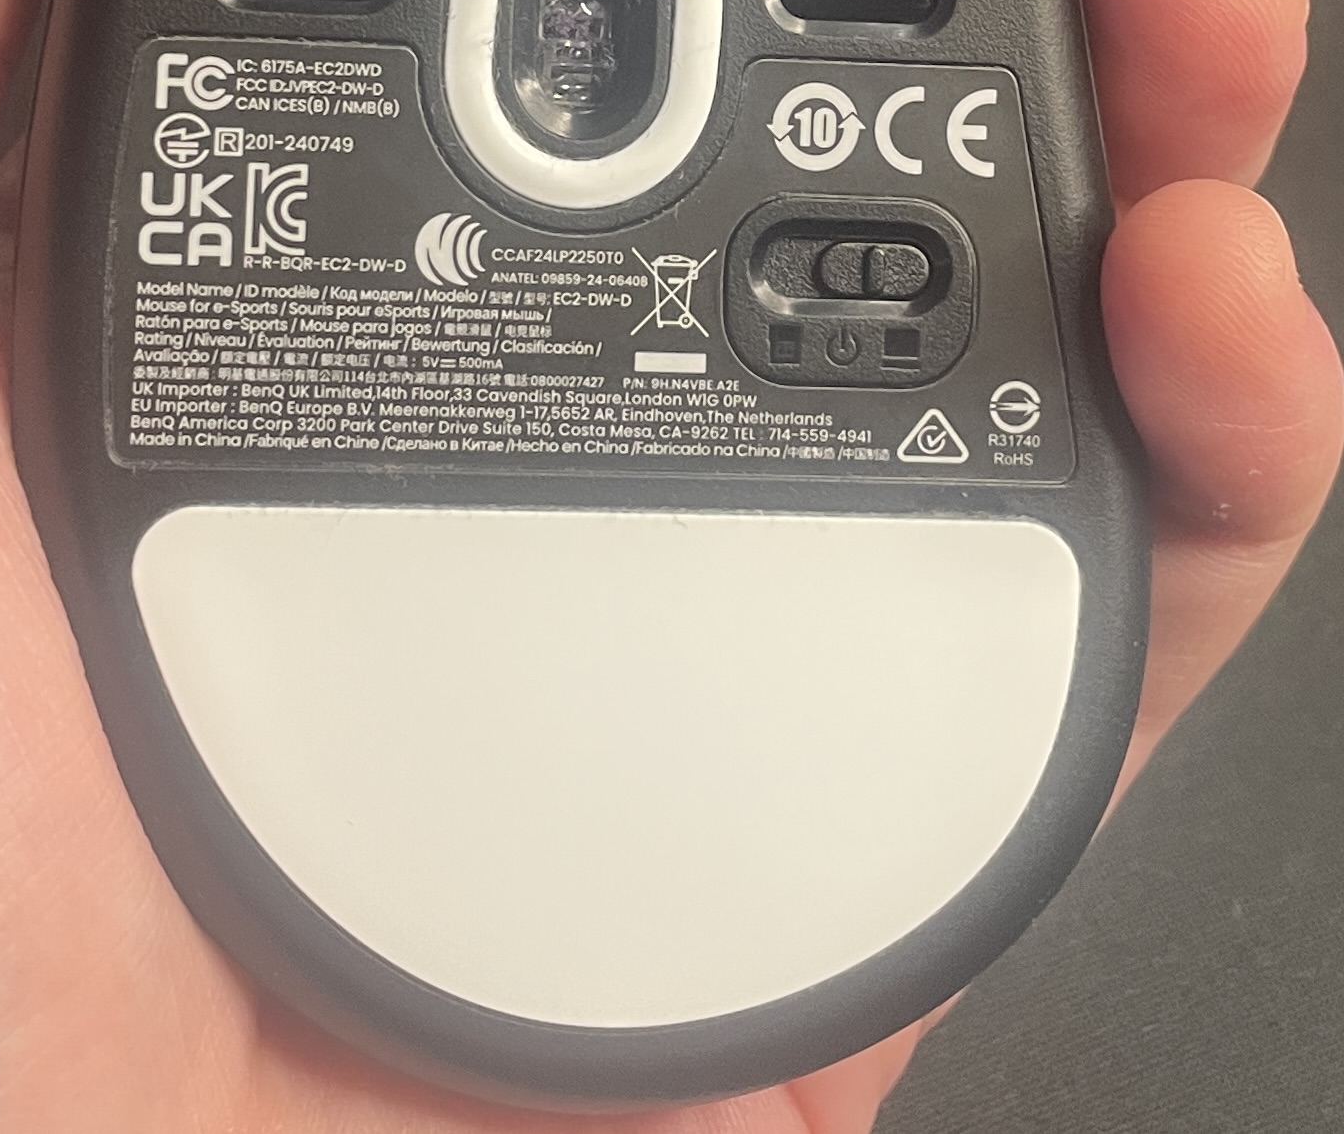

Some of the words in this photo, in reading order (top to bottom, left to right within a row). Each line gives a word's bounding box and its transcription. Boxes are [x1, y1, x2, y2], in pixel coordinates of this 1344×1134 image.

[261, 60, 382, 77] 6175A-EC2DWD
[236, 79, 267, 93] FCC
[235, 97, 270, 111] CAN
[274, 98, 330, 116] ICES(B)
[342, 99, 400, 118] NMB(B)
[794, 107, 837, 149] 10
[874, 86, 998, 178] CE
[244, 133, 354, 152] 201-240749
[140, 171, 235, 218] UK
[138, 221, 233, 266] CA
[243, 255, 406, 273] R-R-BQR-EC2-DW-D
[541, 273, 649, 287] 09859-24-06408
[136, 282, 184, 296] Model
[186, 283, 234, 297] Name
[244, 285, 259, 298] ID
[261, 285, 319, 299] modèle
[424, 289, 478, 303] Modelo
[553, 292, 632, 307] EC2-DW-D
[136, 299, 187, 313] Mouse
[189, 300, 209, 314] for
[213, 301, 278, 318] e-Sports
[289, 303, 334, 316] Souris
[336, 304, 372, 321] pour
[374, 305, 430, 322] eSports
[135, 315, 180, 329] Ratón
[183, 316, 220, 333] para
[223, 317, 288, 335] e-Sports
[300, 319, 350, 333] Mouse
[352, 320, 389, 337] para
[390, 321, 432, 338] jogos
[134, 332, 184, 349] Rating
[194, 333, 247, 347] Niveau
[257, 334, 334, 349] Évaluation
[411, 338, 491, 355] Bewertung
[500, 340, 594, 355] Clasificación
[458, 357, 503, 370] 500mA
[132, 381, 154, 395] UK
[158, 382, 229, 400] Importer
[241, 384, 284, 400] BenQ
[289, 385, 310, 399] UK
[411, 387, 472, 404] Floor,33
[476, 388, 561, 404] Cavendish
[131, 399, 151, 412] EU
[156, 399, 227, 417] Importer
[239, 401, 282, 417] BenQ
[286, 402, 343, 420] Europe
[347, 403, 375, 417] B.V.
[379, 403, 516, 422] Meerenakkerweg
[519, 406, 590, 423] 1-17,5652
[594, 408, 617, 424] AR,
[738, 411, 833, 426] Netherlands
[130, 415, 174, 432] BenQ
[179, 416, 248, 431] America
[252, 418, 293, 436] Corp
[297, 419, 336, 433] 3200
[340, 419, 375, 434] Park
[379, 420, 435, 435] Center
[438, 421, 478, 436] Drive
[483, 422, 522, 437] Suite
[526, 423, 555, 439] 150,
[558, 424, 606, 438] Costa
[610, 425, 655, 441] Mesa,
[659, 425, 729, 441] CA-9262
[768, 428, 872, 444] 714-559-4941
[988, 433, 1041, 447] R31740
[130, 433, 175, 446] Made
[178, 433, 192, 447] in
[195, 434, 242, 448] China
[311, 438, 331, 449] en
[334, 436, 379, 450] Chine
[562, 443, 581, 454] en
[584, 441, 629, 455] China
[713, 446, 734, 457] na
[736, 444, 780, 458] China
[993, 452, 1034, 466] RoHS
